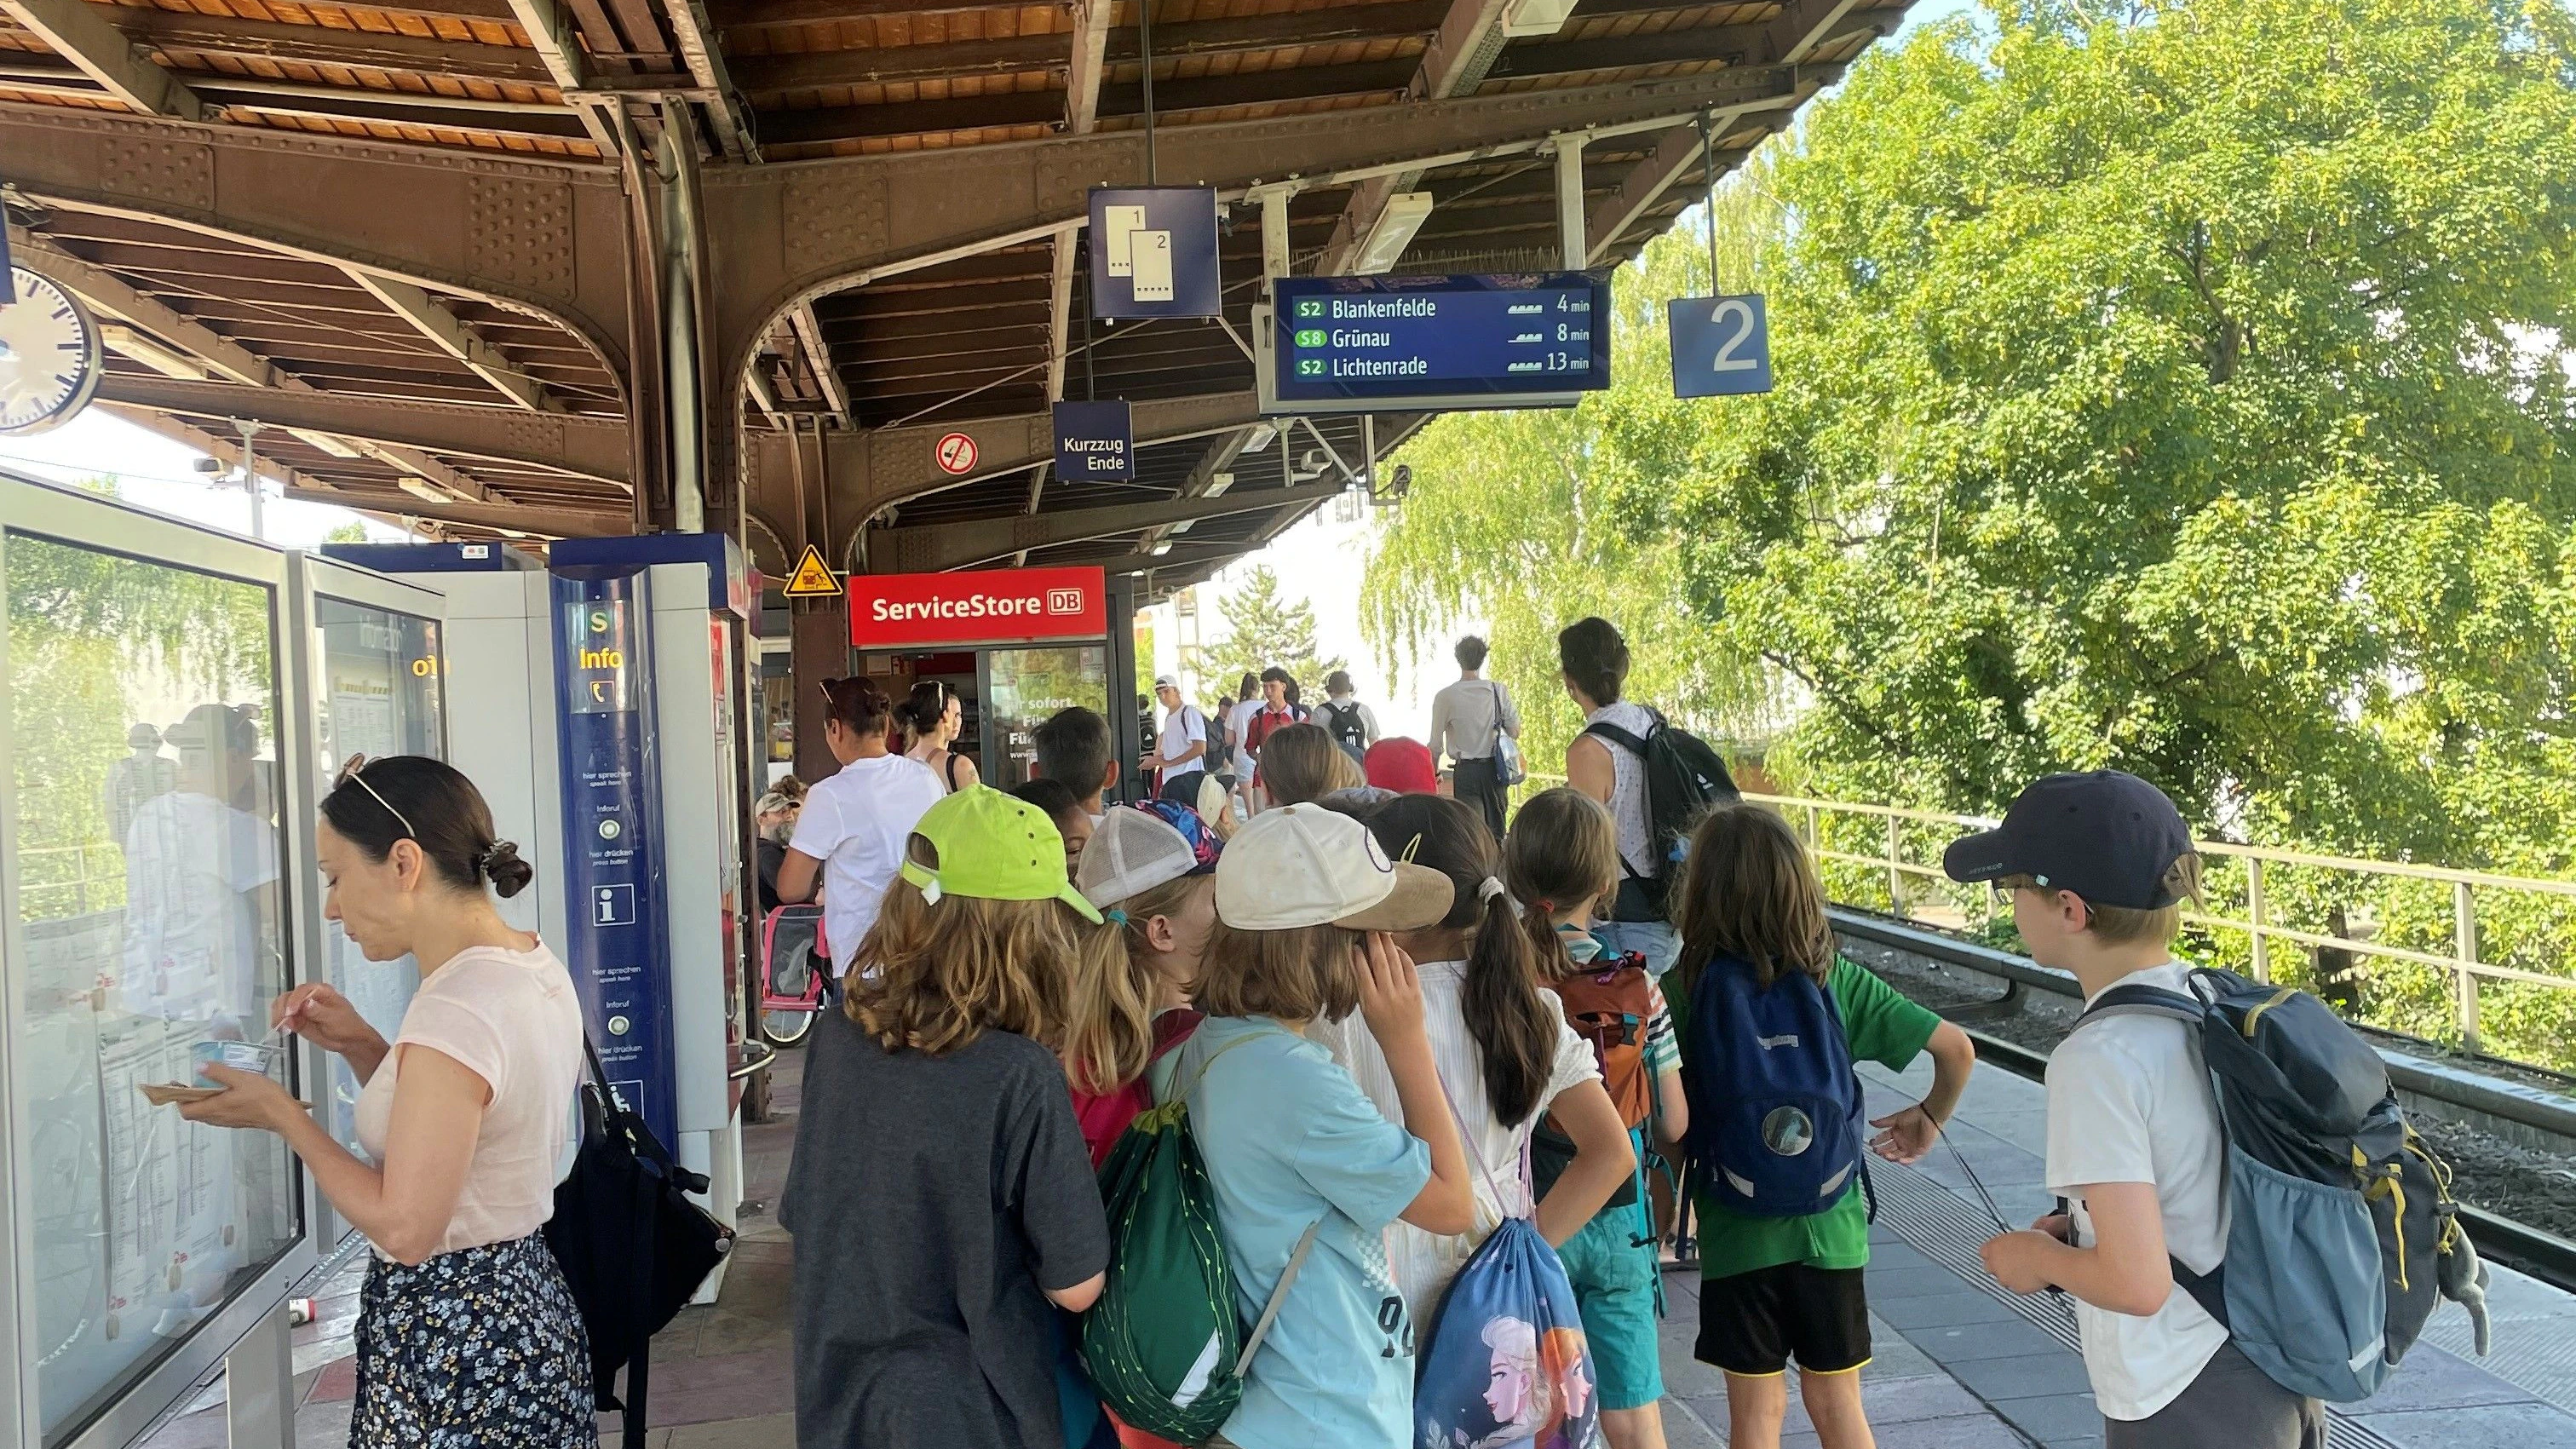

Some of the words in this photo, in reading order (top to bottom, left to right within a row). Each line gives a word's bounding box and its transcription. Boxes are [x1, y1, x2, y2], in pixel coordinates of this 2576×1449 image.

[1133, 210, 1140, 224] 1
[1157, 234, 1166, 249] 2
[1300, 302, 1321, 317] S2
[1332, 298, 1436, 319] Blankenfelde
[1557, 294, 1568, 313] 4
[1570, 300, 1590, 313] min
[1300, 331, 1322, 346] S8
[1332, 329, 1390, 348] Grünau
[1557, 323, 1567, 342] 8
[1570, 329, 1590, 342] min
[1711, 299, 1758, 372] 2
[1300, 360, 1322, 375] S2
[1333, 356, 1428, 377] Lichtenrade
[1547, 352, 1567, 371] 13
[1570, 358, 1590, 370] min
[1064, 437, 1124, 454] Kurzzug
[1087, 455, 1124, 471] Ende
[871, 594, 1041, 622] ServiceStore
[1051, 591, 1080, 611] DB
[590, 612, 609, 633] S
[579, 647, 624, 670] Info
